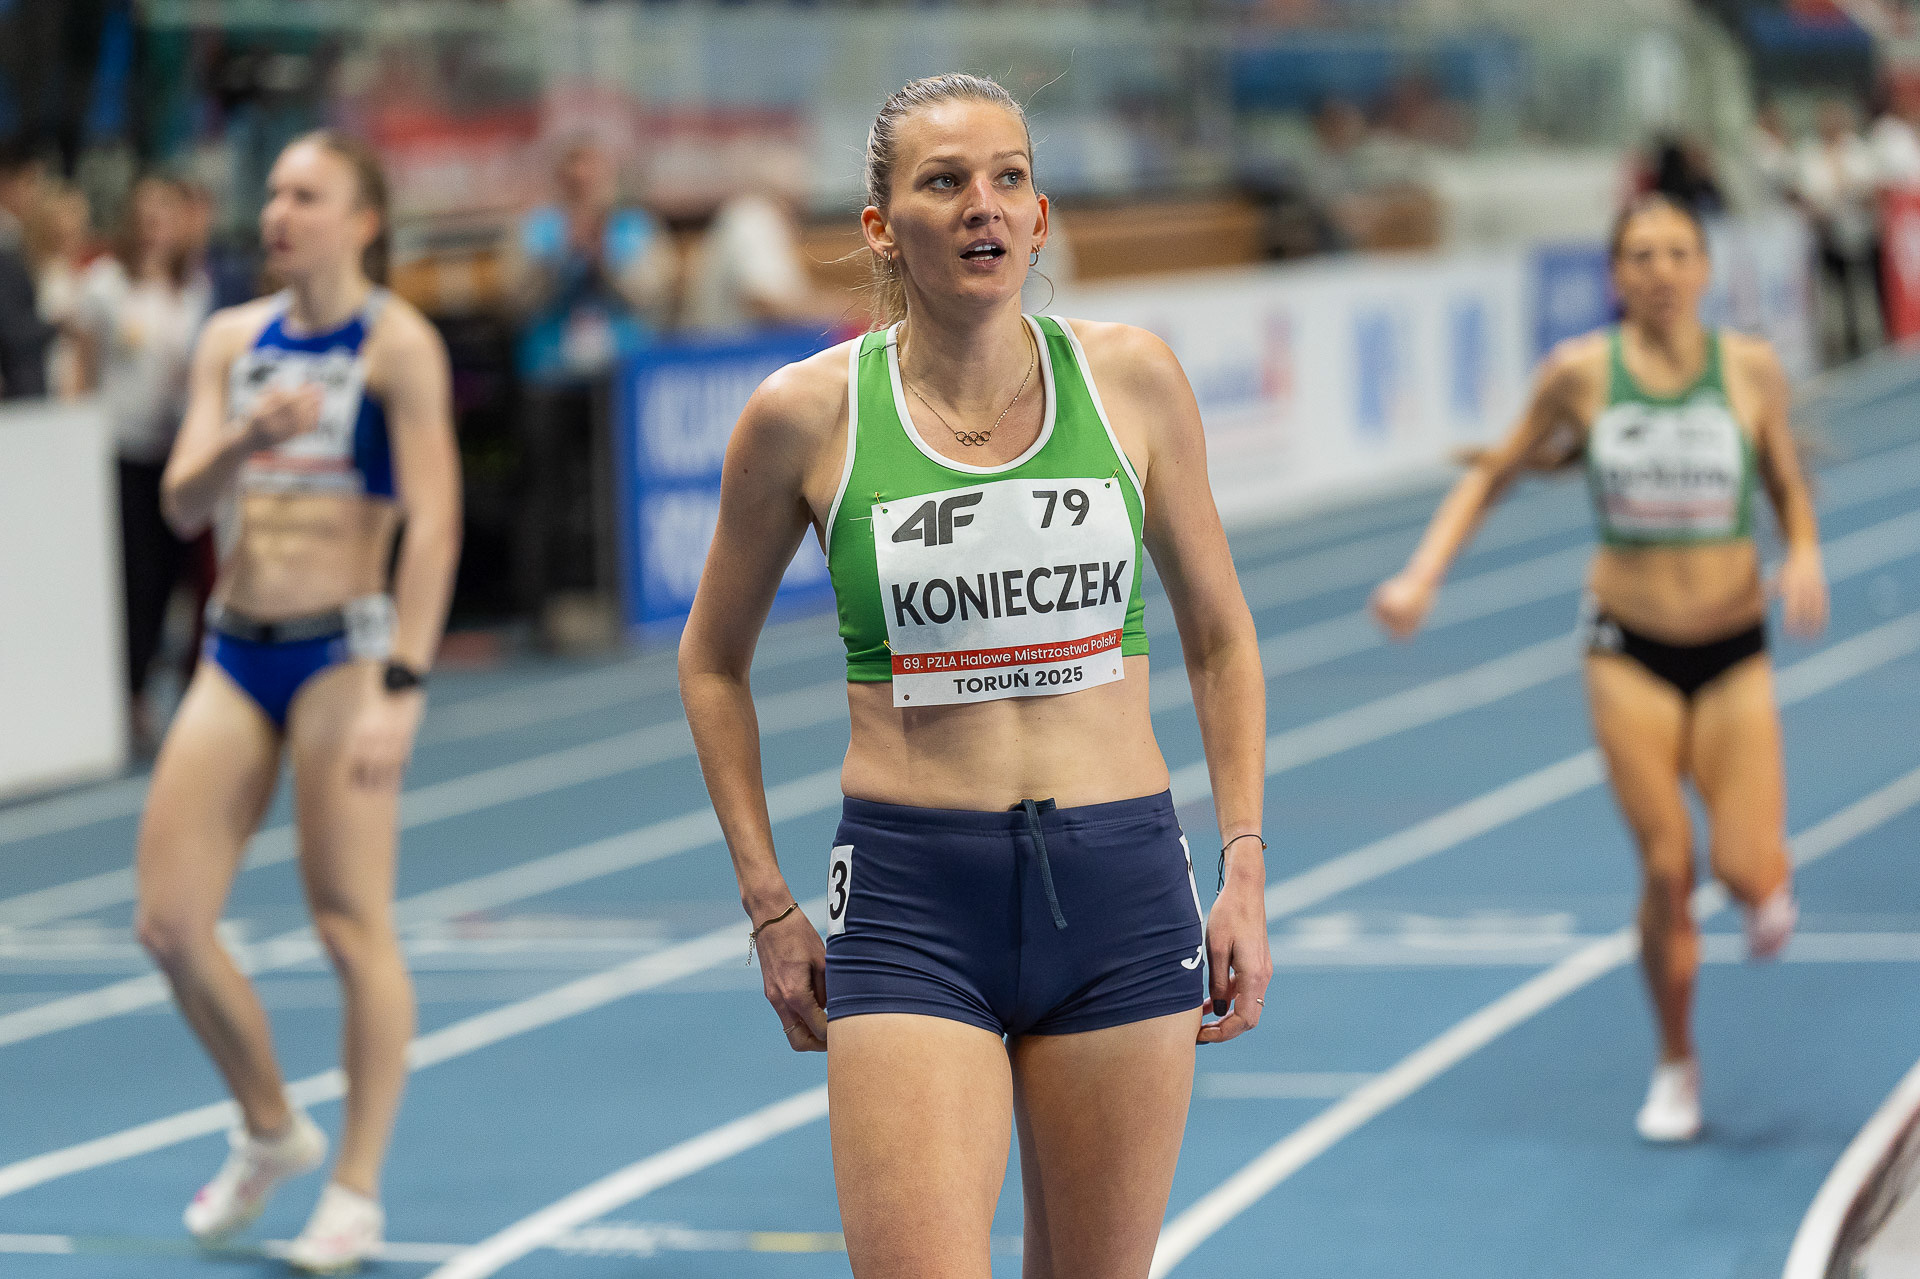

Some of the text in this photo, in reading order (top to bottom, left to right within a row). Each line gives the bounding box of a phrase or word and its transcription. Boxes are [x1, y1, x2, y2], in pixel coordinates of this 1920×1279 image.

[891, 491, 984, 547] 4F
[1032, 488, 1090, 529] 79
[891, 560, 1128, 628] KONIECZEK
[903, 633, 1117, 670] 69. PZLA Halowe Mistrzostwa Polski
[953, 665, 1083, 695] TORUŃ 2025
[829, 860, 848, 920] 3
